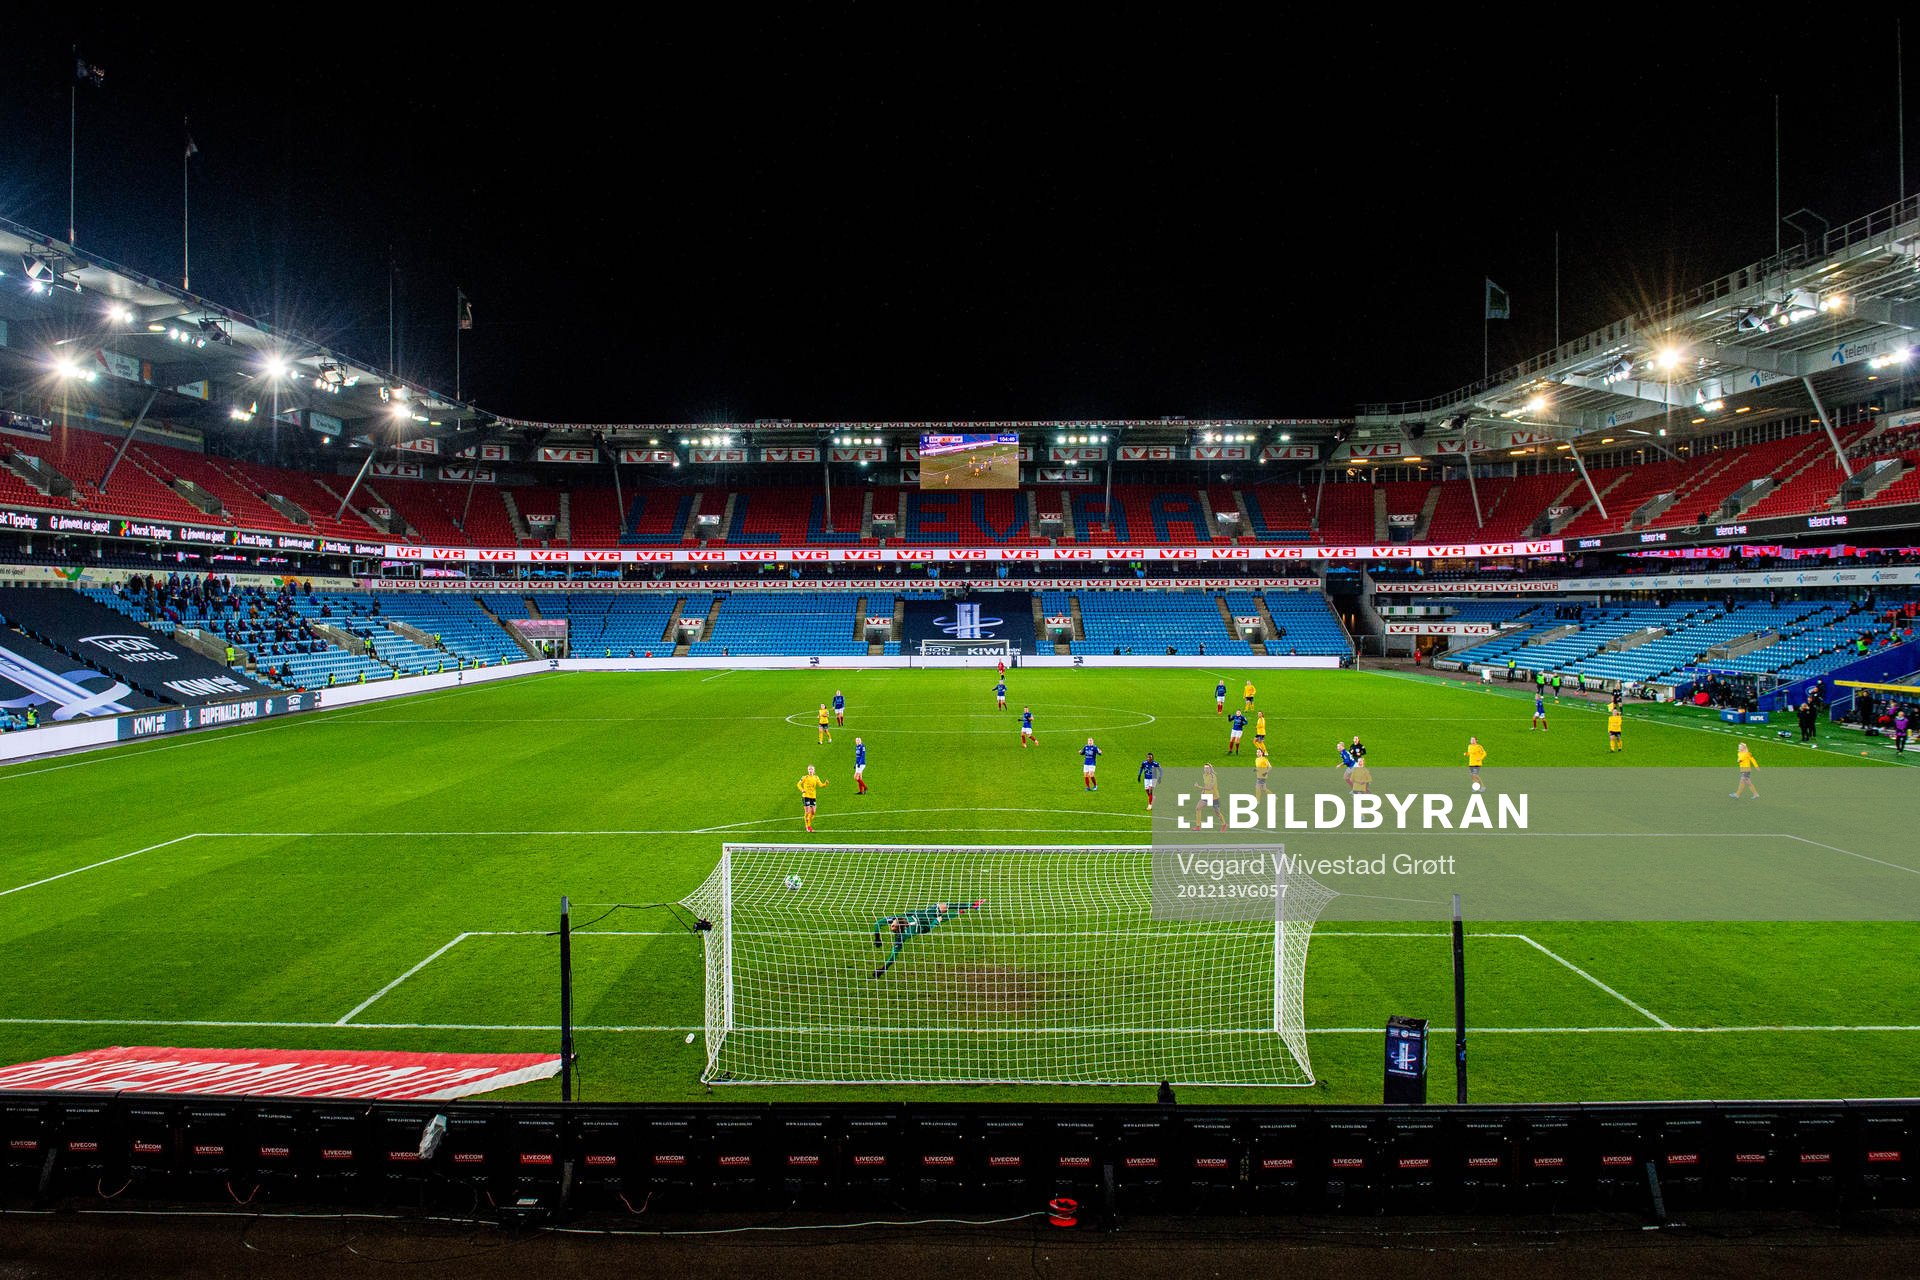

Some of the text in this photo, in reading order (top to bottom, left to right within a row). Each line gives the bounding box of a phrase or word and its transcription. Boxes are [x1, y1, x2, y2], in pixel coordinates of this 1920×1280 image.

[1845, 341, 1877, 358] telenor
[1122, 447, 1169, 459] VG
[1196, 447, 1244, 459] VG
[1265, 446, 1313, 458] VG
[1350, 443, 1401, 457] VG
[1437, 440, 1485, 454] VG
[543, 448, 593, 461] VG
[626, 449, 674, 462] VG
[695, 449, 743, 461] VG
[766, 448, 815, 461] VG
[833, 448, 881, 461] VG
[1053, 448, 1102, 460] VG
[372, 463, 421, 479] VG
[442, 467, 493, 482] VG
[1040, 468, 1089, 480] VG
[8, 513, 38, 529] Tipping
[1807, 516, 1831, 528] telenor
[131, 525, 172, 540] Norsk Tipping
[1715, 526, 1734, 536] telenor
[241, 534, 255, 544] Norsk
[255, 535, 273, 547] Tipping
[397, 542, 1551, 560] VG VG VG VG VG VG VG VG VG VG VG VG VG VG VG VG VG VG VG VG VG VG VG
[378, 580, 393, 588] VG
[1377, 582, 1558, 592] VG VG VG VG VG VG VG
[1046, 617, 1071, 625] VG
[1389, 625, 1489, 633] VG VG VG
[78, 634, 160, 652] THON
[118, 651, 179, 662] HOTELS
[967, 647, 1004, 655] KIWI
[162, 676, 233, 697] KIWI
[200, 701, 258, 724] CUPFINALEN 2020
[133, 717, 156, 735] KIWI
